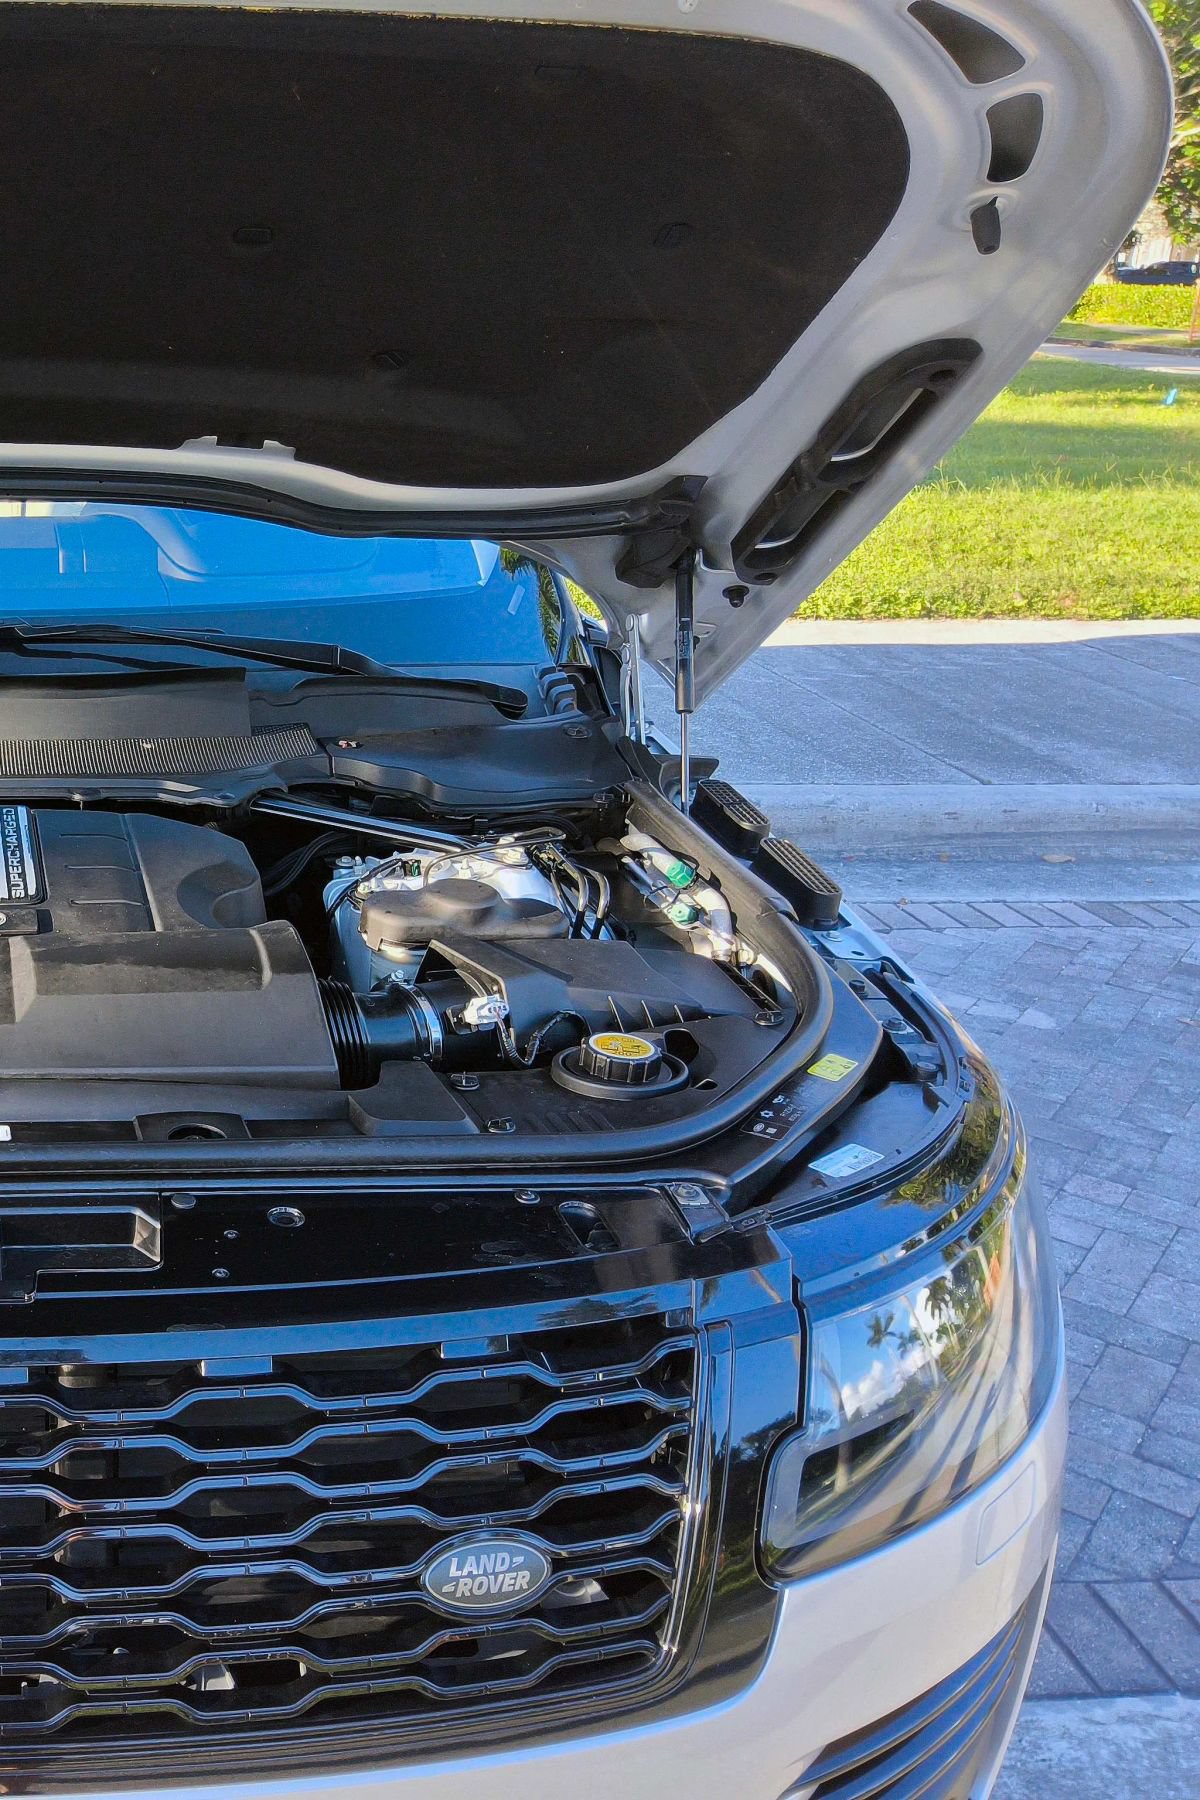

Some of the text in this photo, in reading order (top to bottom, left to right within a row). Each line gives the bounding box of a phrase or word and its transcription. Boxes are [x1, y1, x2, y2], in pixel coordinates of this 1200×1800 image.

[2, 807, 25, 899] SUPERCHARGED
[448, 1552, 511, 1578] LAND
[455, 1570, 531, 1598] ROVER
